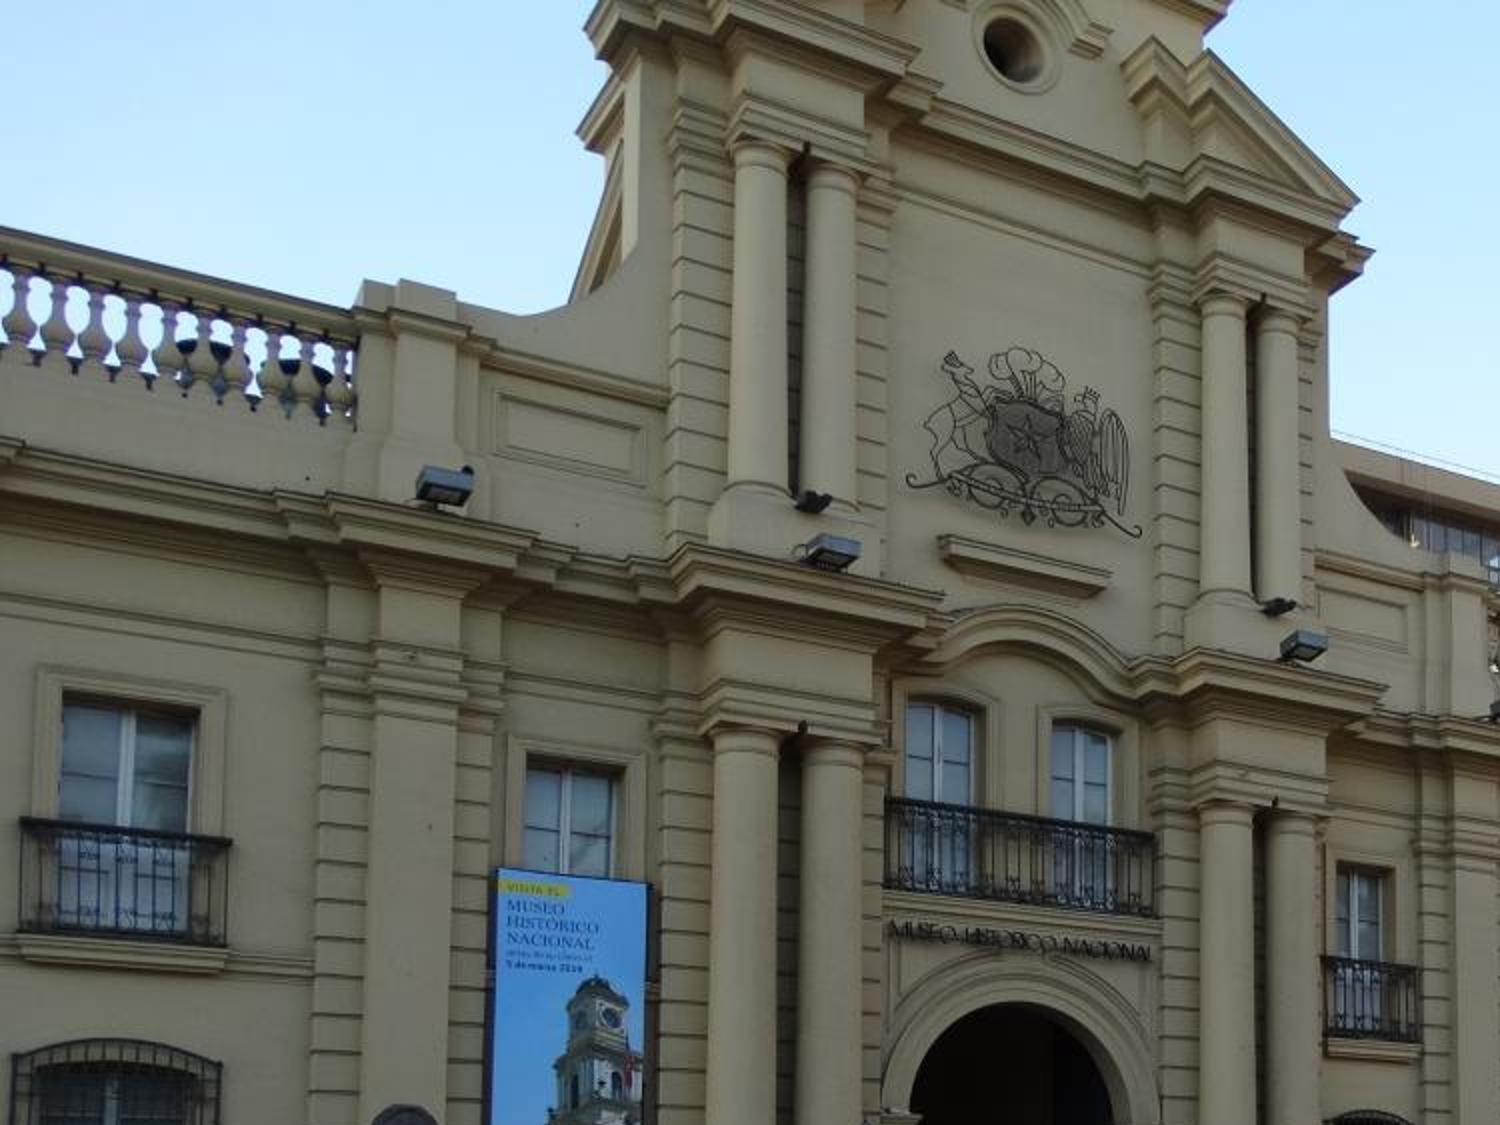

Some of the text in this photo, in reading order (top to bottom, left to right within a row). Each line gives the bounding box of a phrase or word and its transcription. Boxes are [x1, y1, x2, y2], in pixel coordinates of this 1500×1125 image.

[506, 899, 566, 915] MUSEO
[506, 914, 600, 935] HISTÓRICO
[506, 931, 596, 951] NACIONAL
[888, 918, 957, 944] MUSEO
[1063, 936, 1151, 961] NACIONAL
